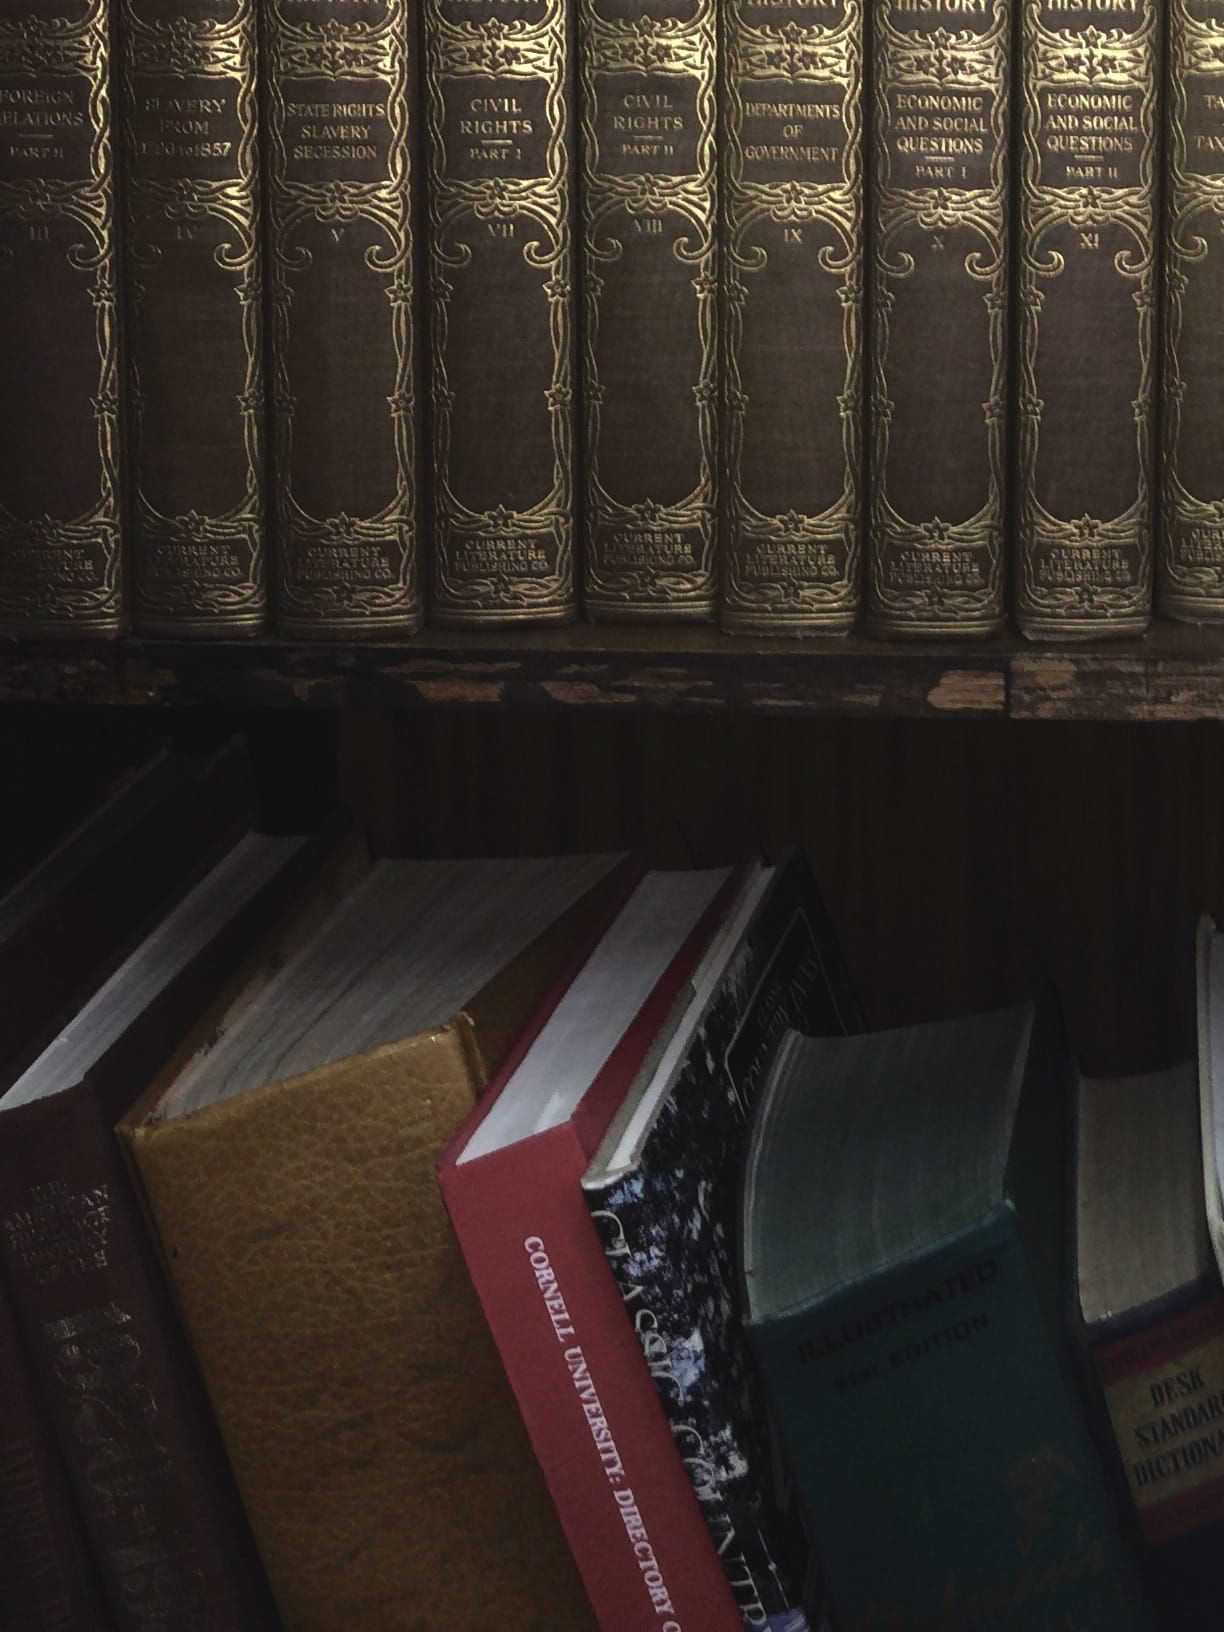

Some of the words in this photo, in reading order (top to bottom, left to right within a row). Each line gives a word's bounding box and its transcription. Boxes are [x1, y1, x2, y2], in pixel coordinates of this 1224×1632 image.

[286, 103, 329, 118] STATE
[332, 103, 386, 118] RIGHTS
[470, 98, 522, 113] CIVIL
[744, 102, 840, 119] DEPARTMENTS
[896, 95, 983, 111] ECONOMIC
[459, 118, 534, 135] RIGHTS
[782, 123, 803, 139] OF
[895, 115, 930, 132] AND
[932, 115, 987, 132] SOCIAL
[300, 125, 370, 140] SLAVERY
[293, 144, 378, 160] SECESSION
[744, 145, 838, 162] GOVERNMENT
[896, 137, 984, 154] QUESTIONS
[915, 164, 956, 179] PART
[783, 229, 803, 243] IX
[464, 537, 539, 551] CURRENT
[797, 1258, 999, 1364] ILLUSTRATED
[1151, 1368, 1206, 1407] DESK
[523, 1235, 575, 1342] CORNELL
[564, 1345, 625, 1486] UNIVERSITY:
[613, 1488, 675, 1617] DIRECTORY
